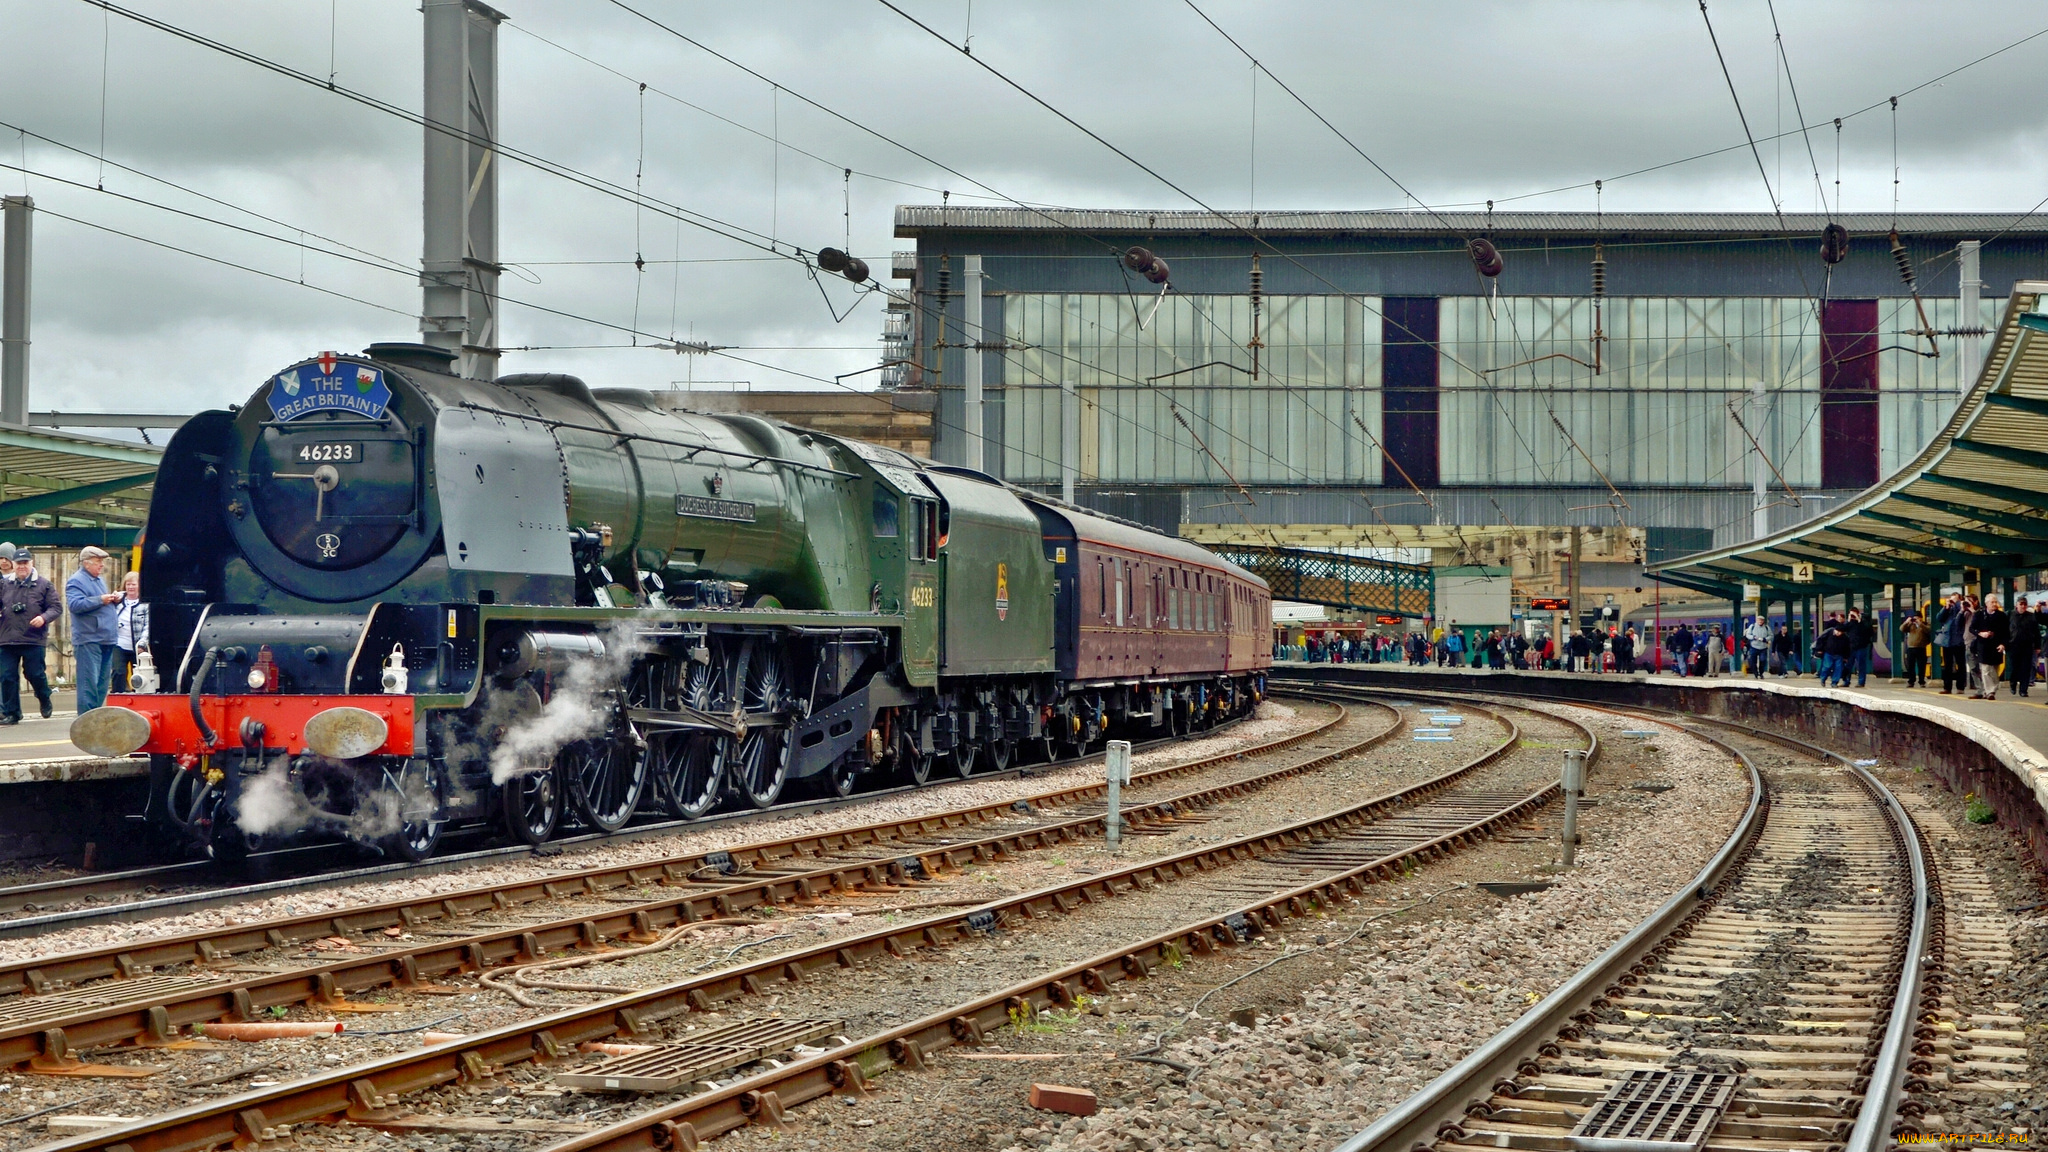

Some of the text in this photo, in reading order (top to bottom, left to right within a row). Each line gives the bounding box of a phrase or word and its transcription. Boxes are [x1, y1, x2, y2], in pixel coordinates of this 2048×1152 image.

[311, 377, 343, 392] THE
[278, 394, 382, 420] GREAT BRITAIN V
[300, 444, 353, 461] 46233
[680, 496, 754, 518] DUCHESS OF SUTHERLAND
[1799, 566, 1809, 578] 4
[911, 586, 933, 607] 46233
